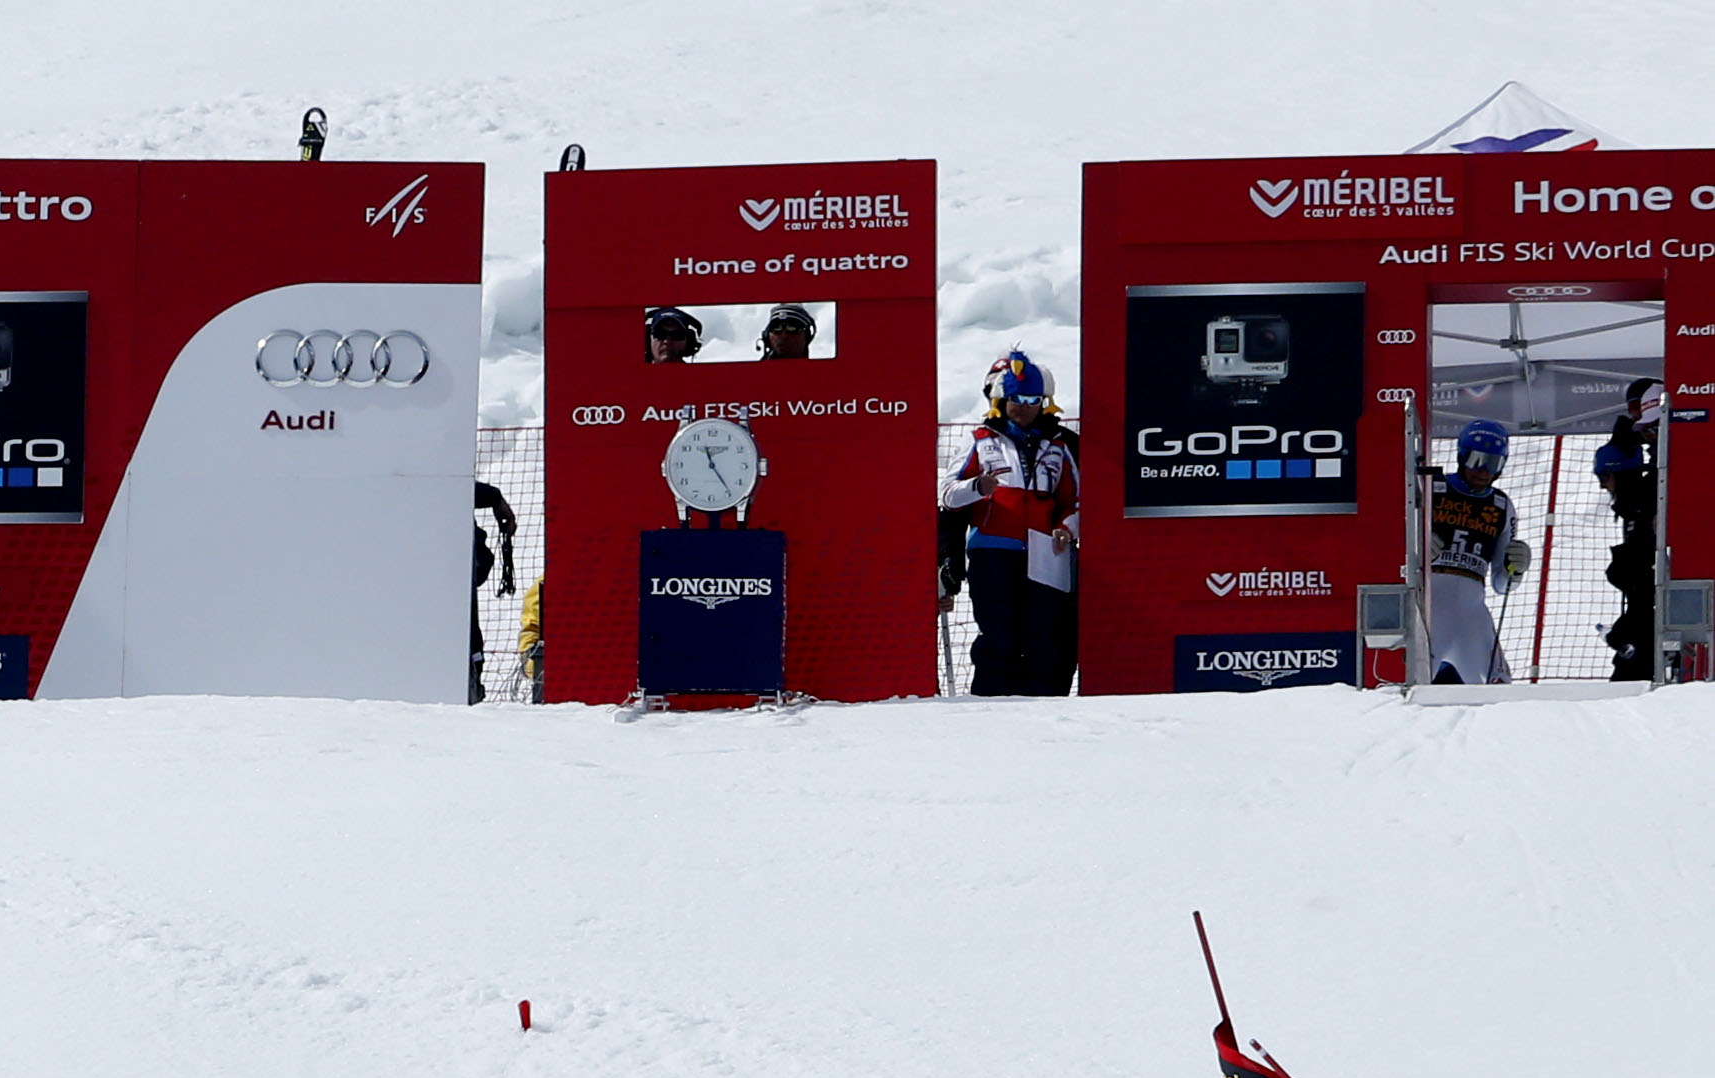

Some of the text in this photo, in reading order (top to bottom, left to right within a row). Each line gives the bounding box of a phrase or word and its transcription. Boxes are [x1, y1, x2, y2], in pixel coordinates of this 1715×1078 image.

[1303, 169, 1455, 205] MÉRIBEL
[1514, 180, 1673, 214] Home
[783, 189, 909, 218] MÉRIBEL
[1303, 202, 1455, 219] cœur des 3 vallées
[784, 217, 909, 231] cœur des 3 vallées
[1379, 238, 1715, 265] Audi FIS Ski World Cup
[674, 253, 909, 276] Home of quattro
[260, 409, 336, 431] Audi
[641, 397, 908, 422] Audi FIS Ski World Cup
[1137, 425, 1343, 457] GoPro
[1140, 464, 1220, 479] Be a HERO.
[1436, 497, 1472, 514] Jack
[1434, 510, 1498, 537] Wolfskin
[650, 577, 772, 596] LONGINES
[1238, 566, 1332, 591] MÉRIBEL
[1266, 588, 1284, 597] des
[1287, 587, 1293, 596] 3
[1196, 648, 1337, 670] LONGINES
